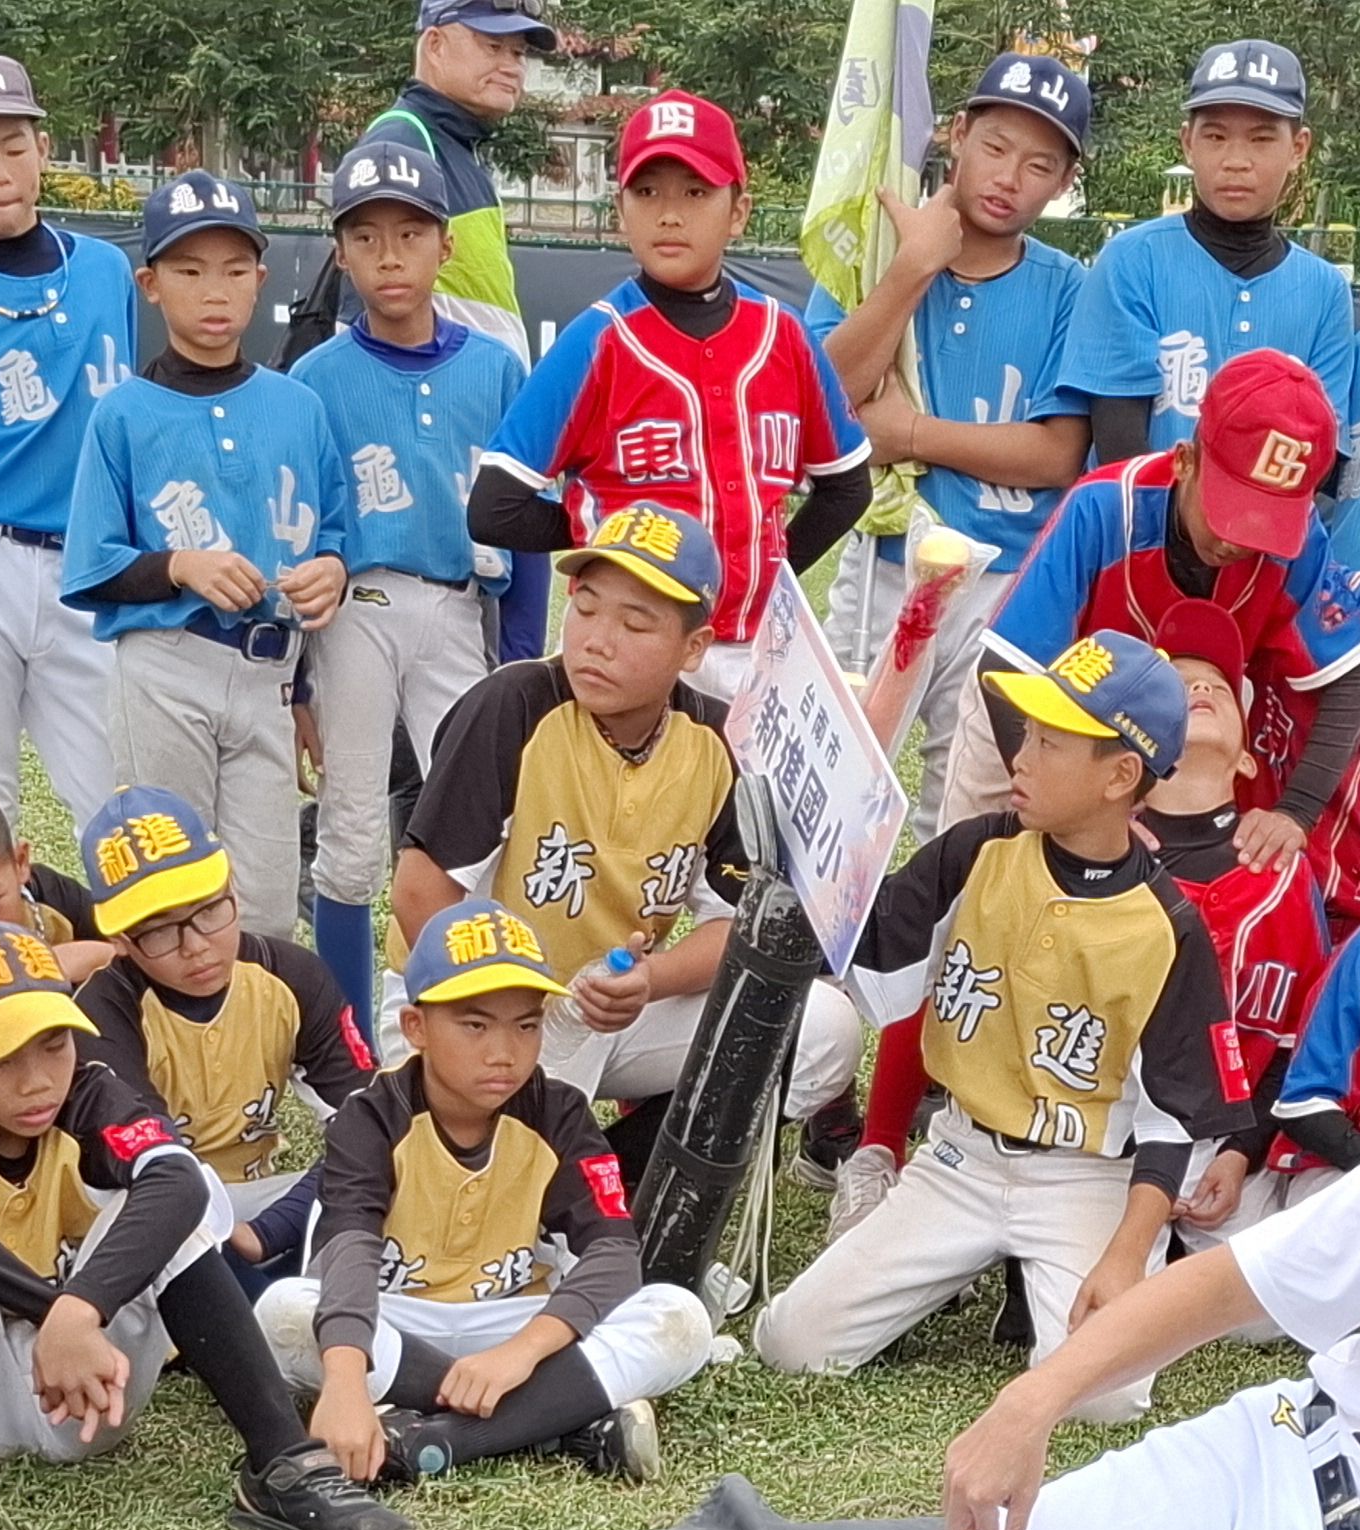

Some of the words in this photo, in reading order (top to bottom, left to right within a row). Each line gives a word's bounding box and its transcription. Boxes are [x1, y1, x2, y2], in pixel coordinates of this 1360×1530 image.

[999, 61, 1069, 112] 龜山
[169, 182, 239, 214] 龜山
[348, 156, 420, 190] 龜山
[754, 685, 844, 883] 新進國小
[95, 812, 191, 889] 新進
[524, 823, 698, 918] 新進
[934, 939, 1107, 1091] 新進
